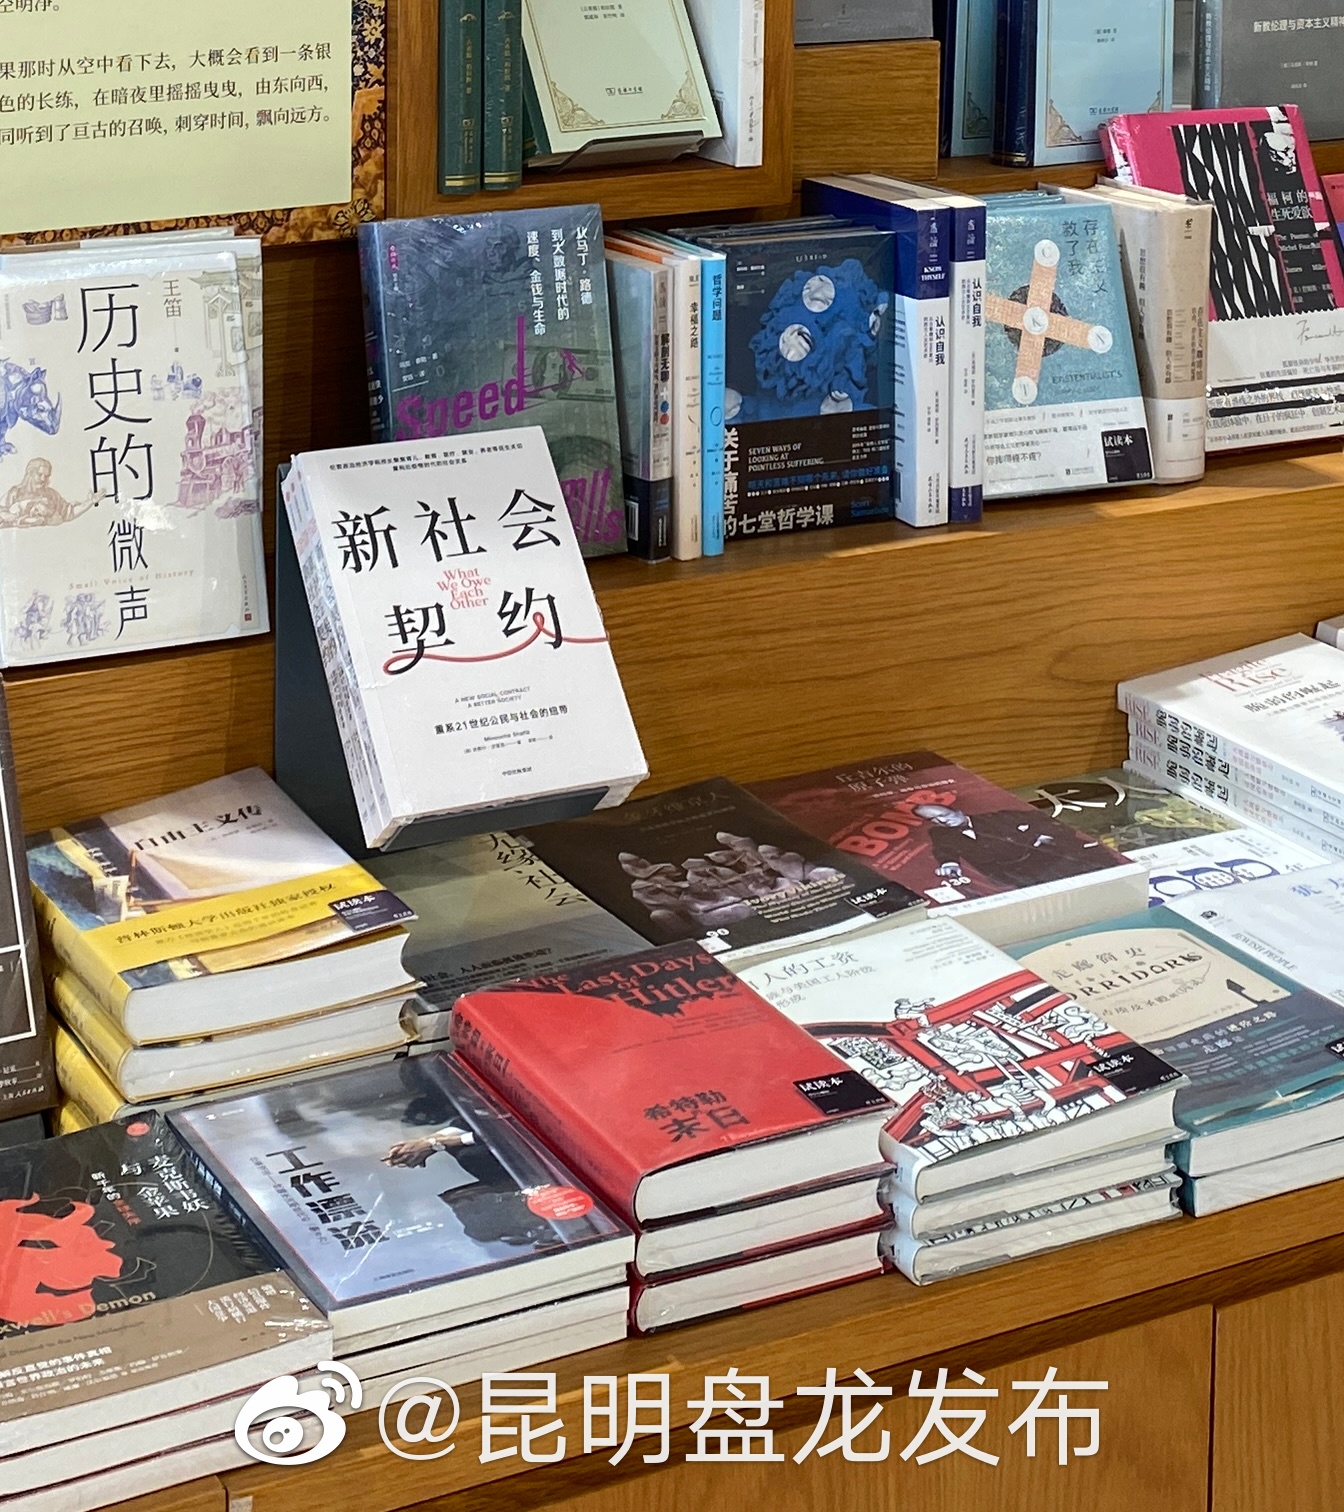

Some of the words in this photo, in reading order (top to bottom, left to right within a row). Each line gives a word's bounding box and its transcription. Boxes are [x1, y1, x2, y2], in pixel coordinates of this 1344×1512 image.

[1266, 189, 1309, 207] 福柯的
[1270, 205, 1314, 221] 生死爱欲
[575, 226, 594, 306] 从马丁·路德
[1061, 220, 1085, 277] 救了我
[526, 230, 547, 337] 速度、金钱与生命
[550, 227, 570, 322] 到大数据时代的
[162, 278, 183, 319] 王笛
[711, 274, 723, 322] 哲学问题
[971, 277, 982, 328] 认识自我
[689, 301, 700, 349] 幸福之路
[934, 315, 946, 367] 认识自我
[396, 315, 527, 442] Speed
[748, 446, 771, 457] SEVEN
[772, 444, 792, 454] WAYS
[748, 454, 780, 465] LOOKING
[1103, 435, 1134, 448] 试读本
[76, 283, 155, 641] 历史的微声
[747, 461, 786, 473] POINTLESS
[786, 456, 825, 469] SUFFERING
[331, 487, 563, 573] 新社会
[436, 579, 459, 592] We
[460, 576, 492, 589] Owe
[442, 567, 481, 582] What
[449, 596, 489, 611] Other
[450, 588, 484, 600] Each
[382, 586, 564, 677] 契约
[1244, 680, 1342, 713] 脆弱的崛起
[1166, 734, 1231, 779] 脆弱的崛起
[133, 802, 264, 854] 自由主义传
[332, 894, 377, 912] 试读本
[850, 887, 888, 906] 试读本
[557, 962, 627, 995] Last
[630, 948, 716, 980] Days
[1050, 945, 1147, 981] 走廊简史
[1261, 946, 1298, 971] PEOPLE
[606, 972, 740, 1015] Hitler
[1093, 1053, 1135, 1074] 试读本
[797, 1075, 845, 1094] 试读本
[642, 1089, 729, 1122] 希特勒
[658, 1105, 751, 1144] 末日
[150, 1154, 210, 1214] 麦克斯韦妖
[138, 1185, 181, 1220] 金苹果
[81, 1290, 157, 1323] Demon
